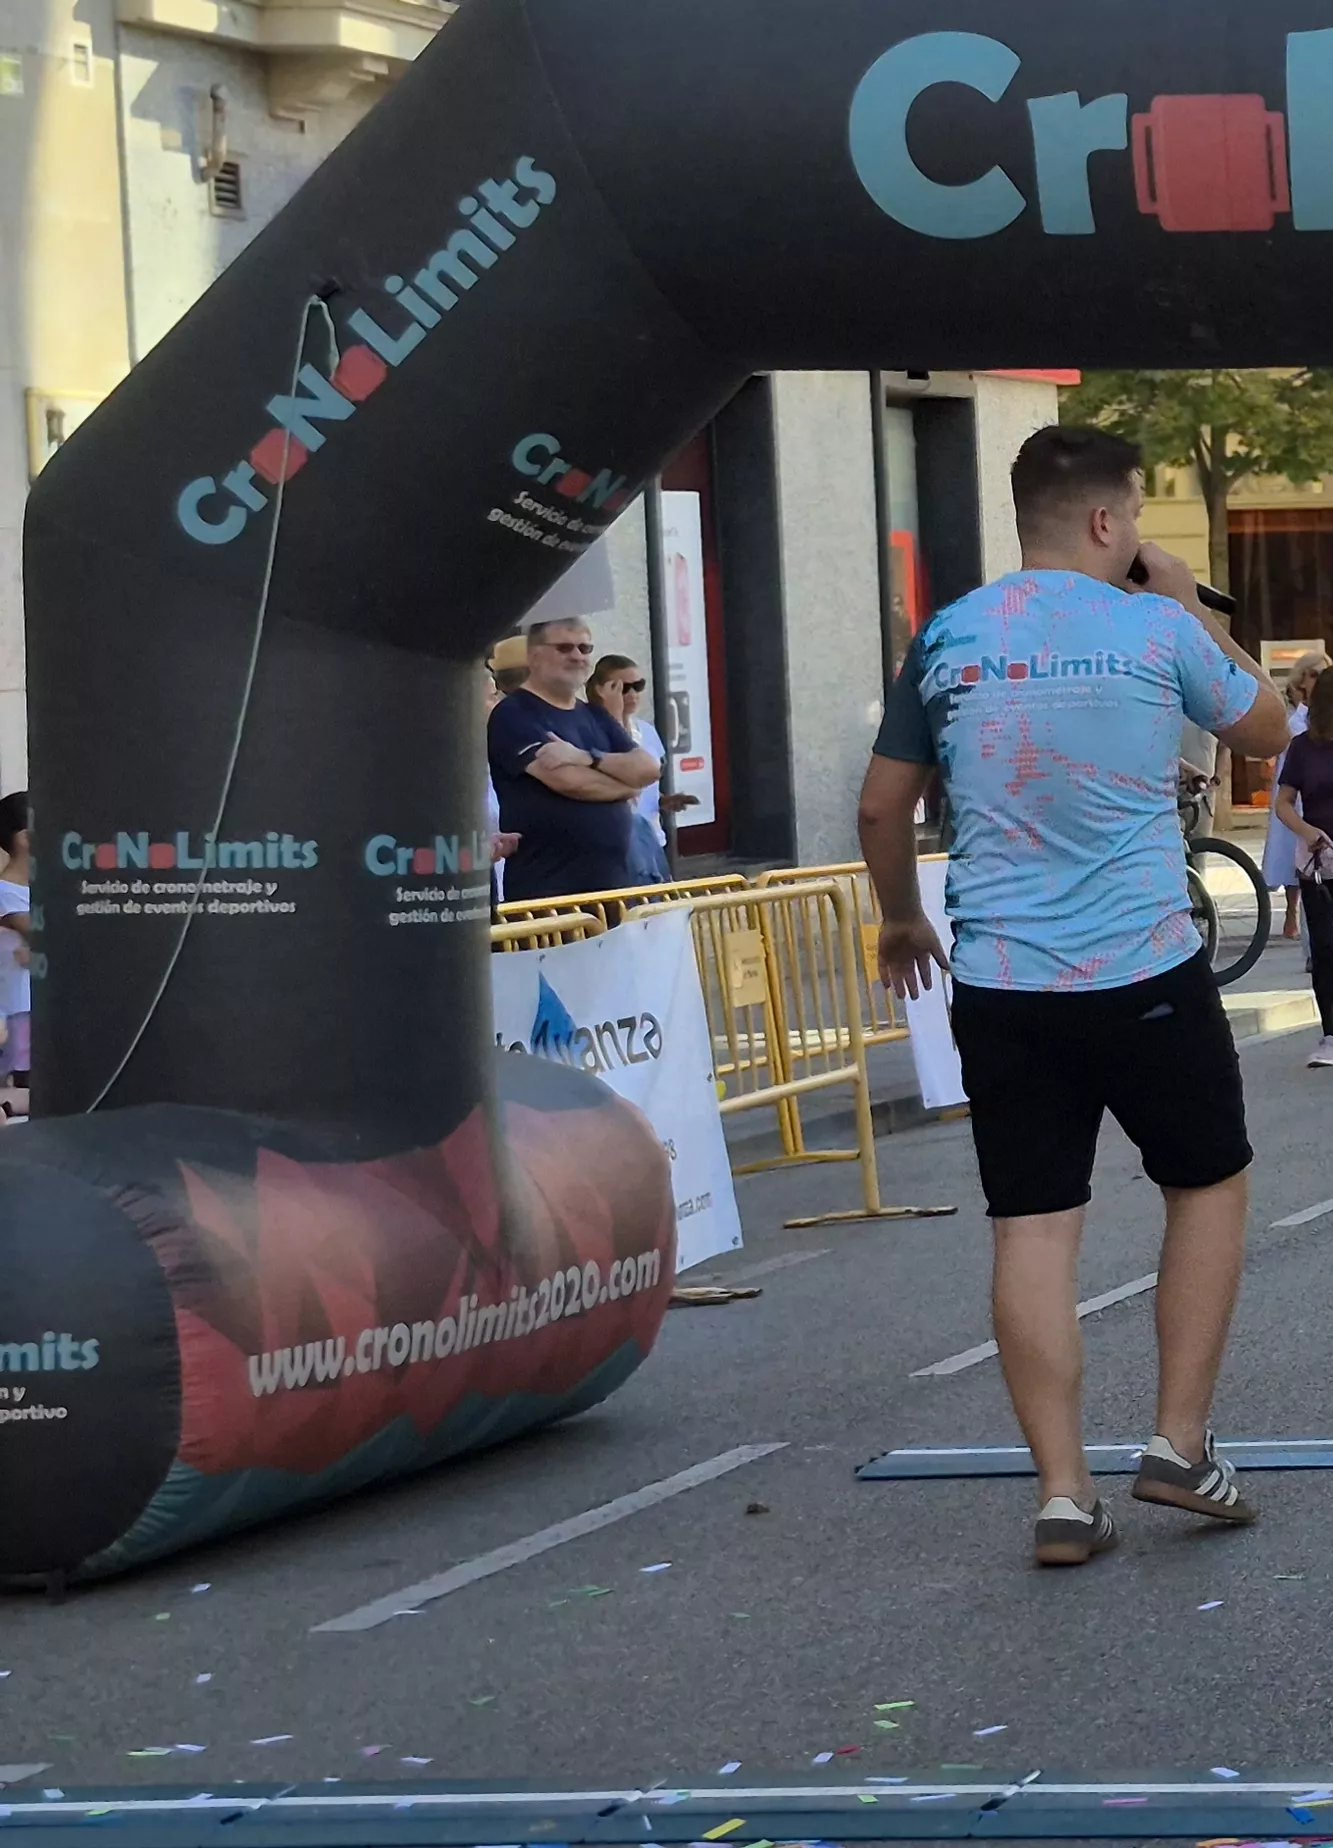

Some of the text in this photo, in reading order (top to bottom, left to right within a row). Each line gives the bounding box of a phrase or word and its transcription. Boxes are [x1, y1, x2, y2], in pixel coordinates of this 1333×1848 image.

[81, 880, 129, 896] Servicio
[131, 879, 150, 895] de
[264, 882, 278, 897] y
[396, 886, 445, 903] Servicio
[76, 900, 121, 916] gestión
[123, 899, 142, 914] de
[207, 899, 296, 914] deportivos
[388, 907, 439, 927] gestión
[248, 1248, 661, 1398] www.cronolimits2020.com
[0, 1330, 100, 1372] mits
[12, 1386, 27, 1402] y
[0, 1404, 69, 1424] portivo
